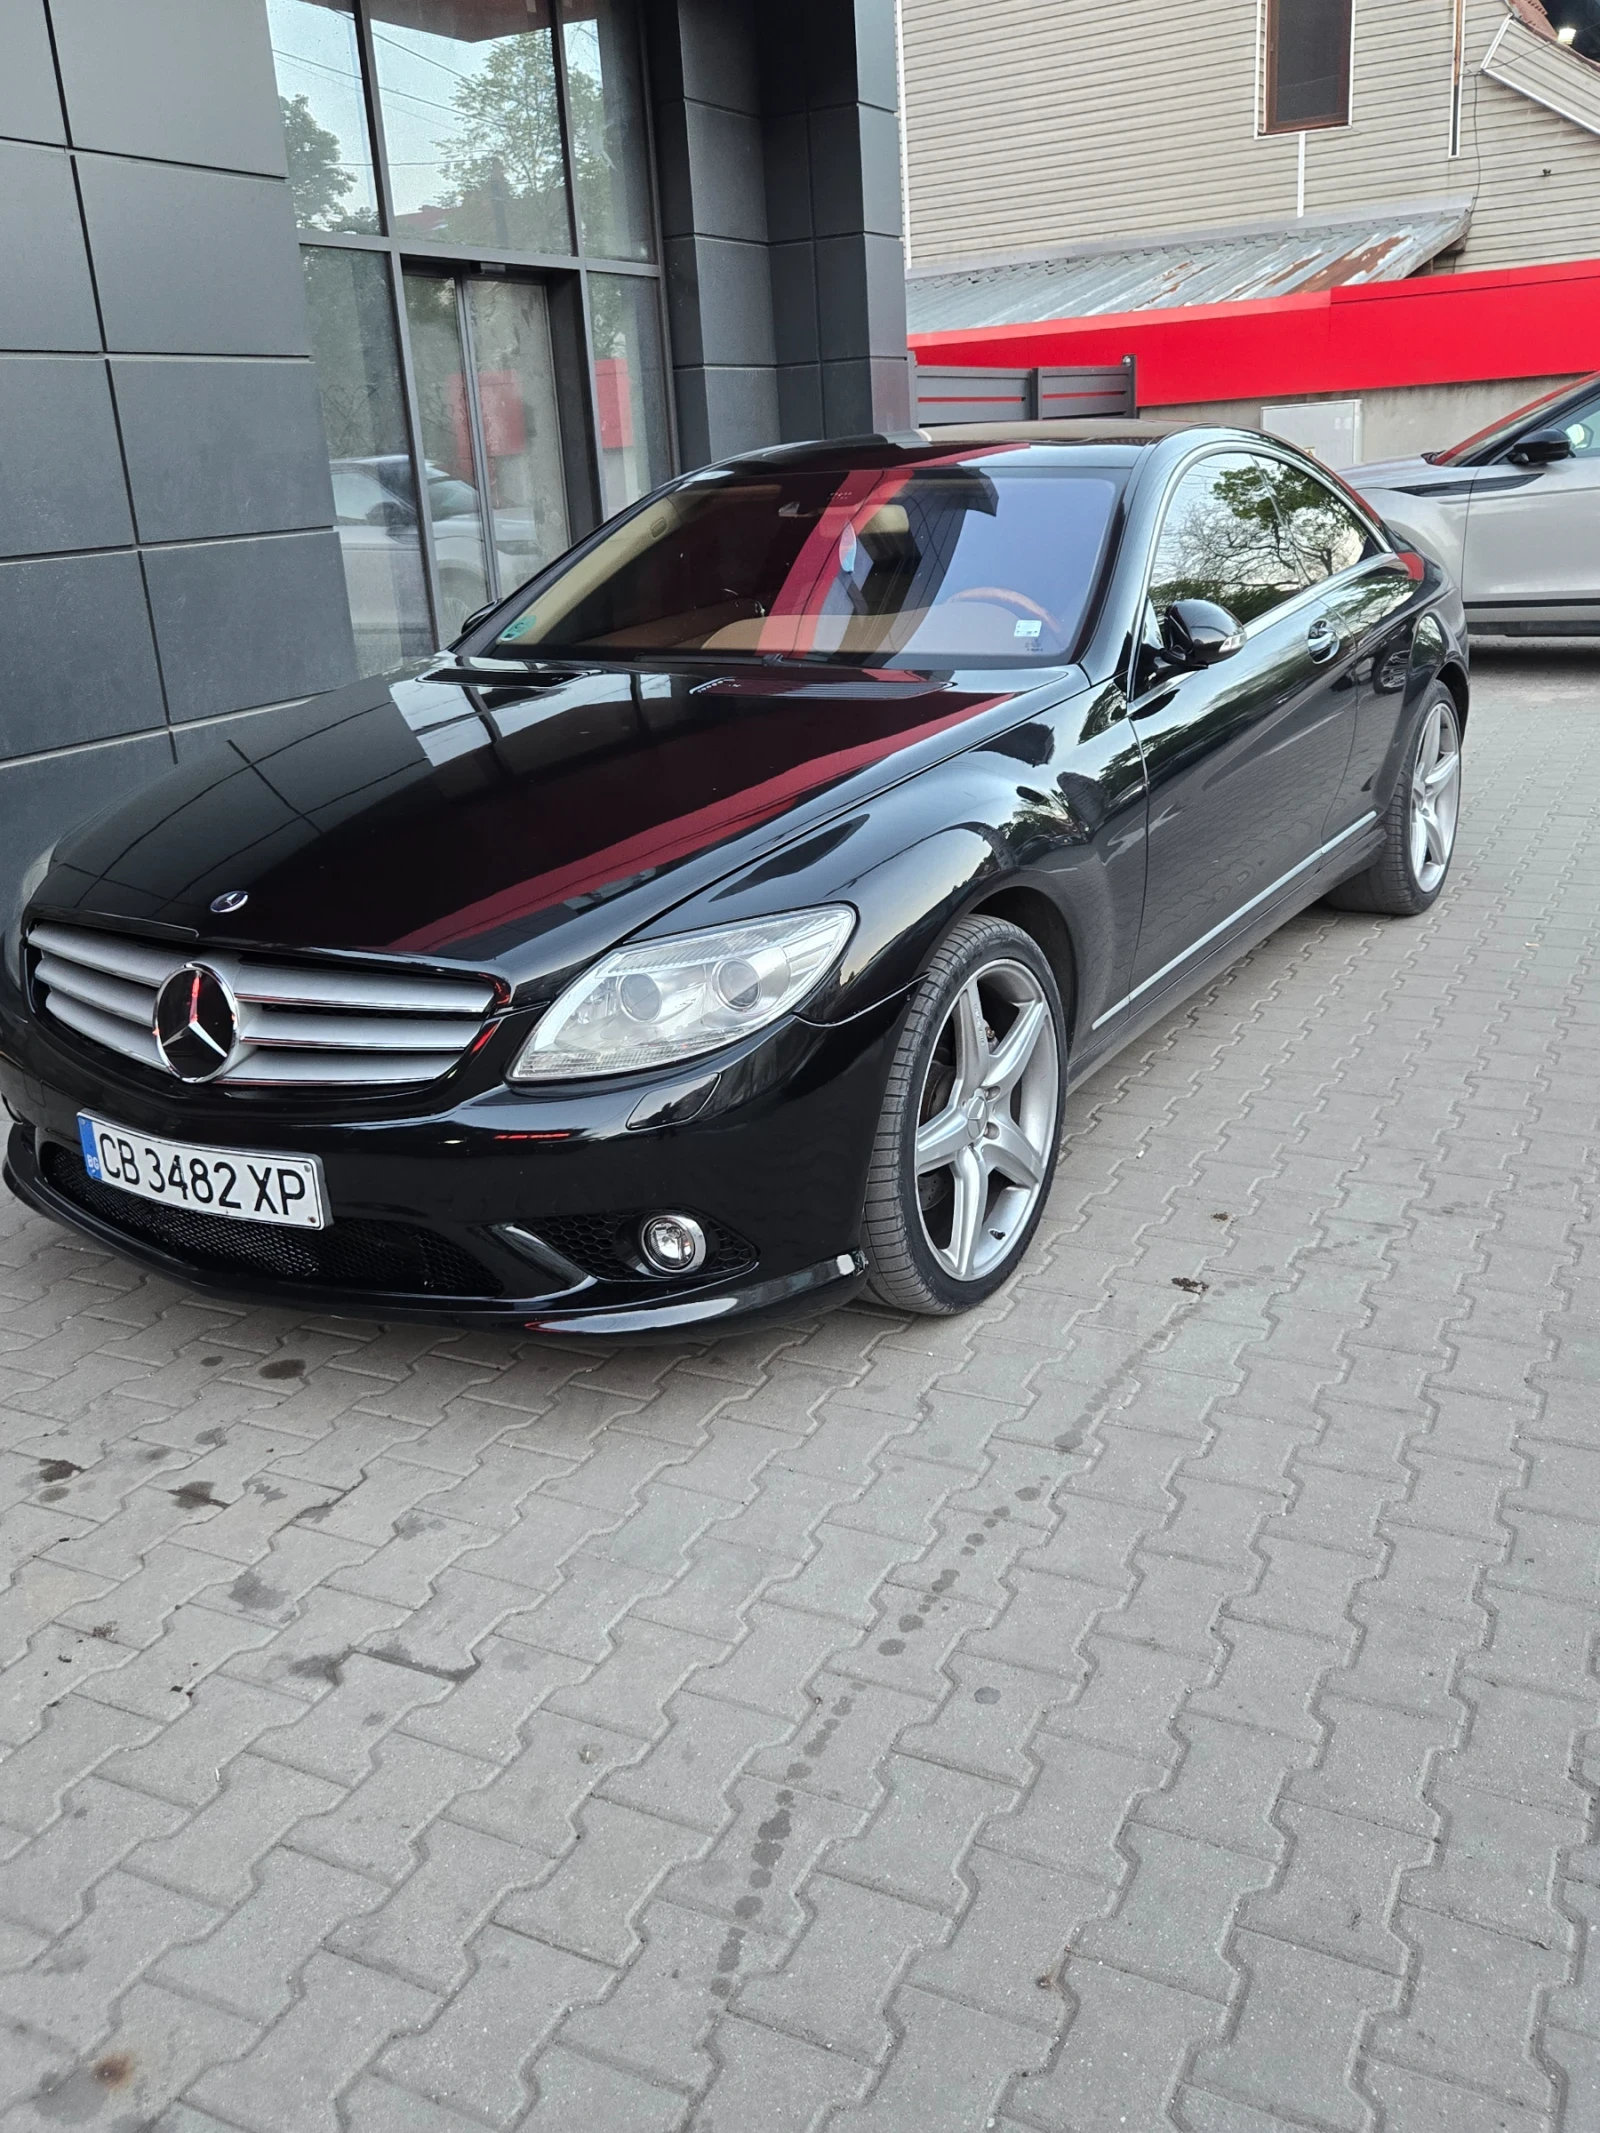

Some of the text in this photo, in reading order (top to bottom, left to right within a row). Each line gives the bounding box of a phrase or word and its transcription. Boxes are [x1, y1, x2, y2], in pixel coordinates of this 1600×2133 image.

[87, 1153, 100, 1170] BG
[99, 1133, 306, 1216] CB 3482 XP
